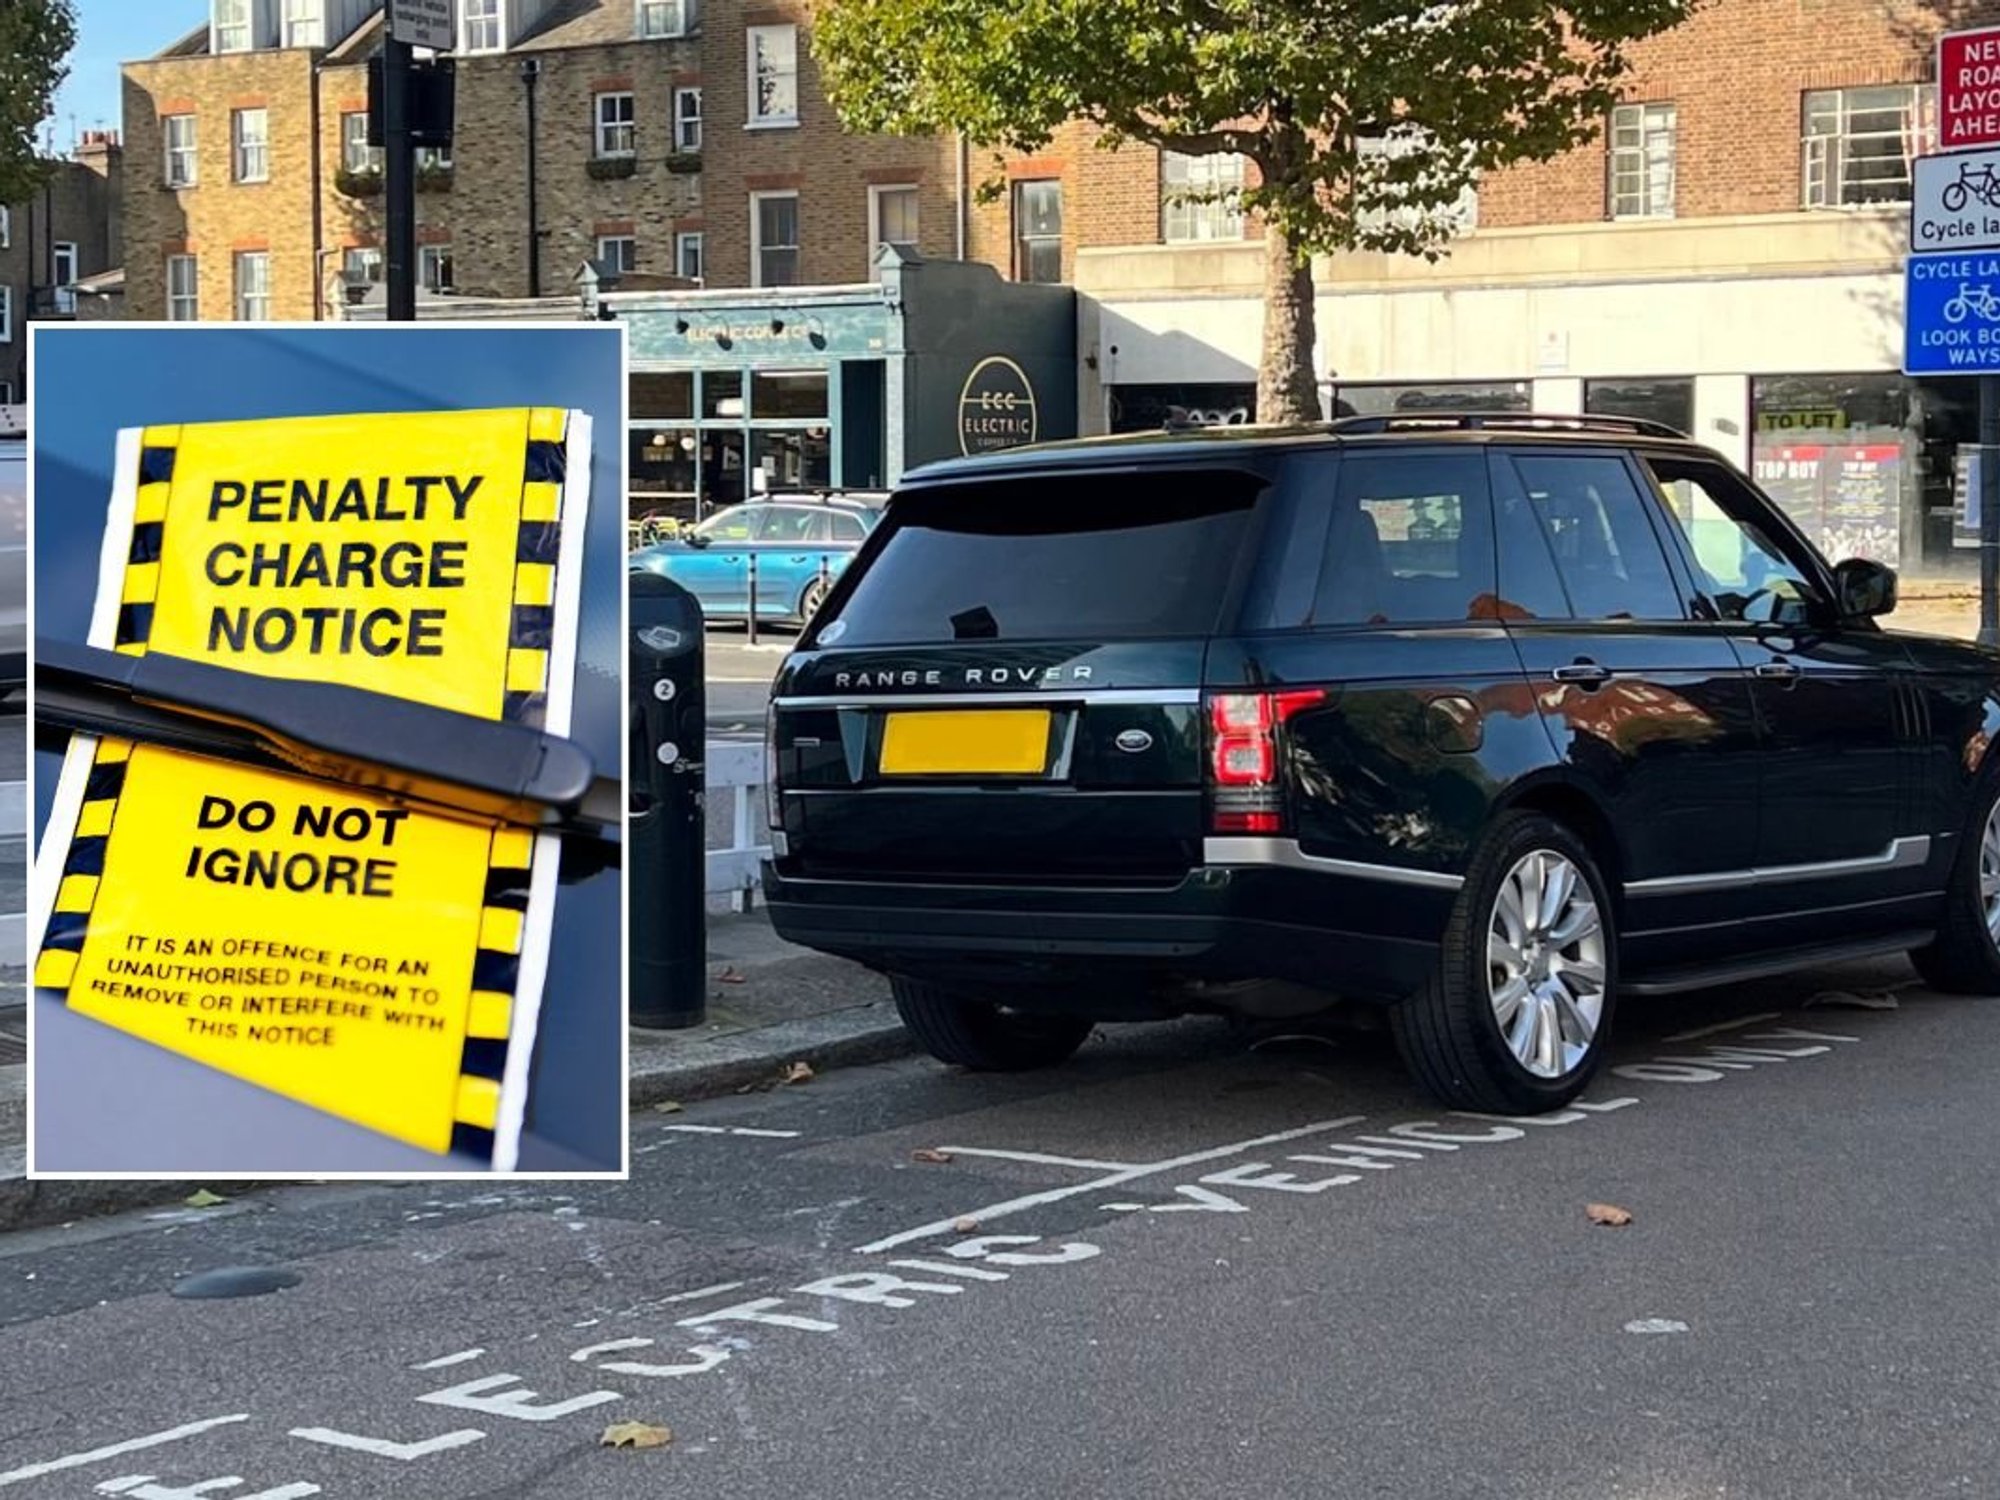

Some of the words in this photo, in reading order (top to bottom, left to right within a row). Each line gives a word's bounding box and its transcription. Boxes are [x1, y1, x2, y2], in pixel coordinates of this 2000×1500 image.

[1964, 39, 2000, 63] NE
[1950, 113, 2000, 138] AHE
[1920, 218, 1975, 242] Cycle
[1913, 260, 1971, 280] CYCLE
[1920, 328, 1971, 347] LOOK
[1949, 346, 2000, 366] WAYS
[982, 391, 1015, 411] ECC
[964, 418, 1030, 434] ELECTRIC
[1765, 413, 1793, 430] TO
[1801, 412, 1838, 429] LET
[1756, 461, 1786, 480] TOP
[1788, 460, 1818, 479] BOY
[207, 475, 483, 522] PENALTY
[205, 541, 468, 588] CHARGE
[207, 606, 447, 657] NOTICE
[835, 671, 941, 688] RANGE
[965, 666, 1093, 683] ROVER
[661, 682, 671, 697] 2
[197, 795, 276, 832] DO
[293, 804, 410, 846] NOT
[186, 846, 398, 898] IGNORE
[126, 934, 148, 952] IT
[154, 938, 176, 955] IS
[183, 938, 213, 956] AN
[222, 939, 332, 966] OFFENCE
[340, 953, 388, 975] FOR
[396, 959, 430, 977] AN
[107, 958, 291, 987] UNAUTHORISED
[299, 970, 399, 1000] PERSON
[408, 986, 440, 1006] TO
[91, 979, 190, 1008] REMOVE
[200, 994, 233, 1012] OR
[241, 996, 373, 1020] INTERFERE
[383, 1008, 446, 1032] WITH
[186, 1016, 238, 1038] THIS
[248, 1024, 336, 1046] NOTICE
[94, 1235, 1101, 1500] ELECTRIC
[1611, 1026, 1861, 1083] ONLY
